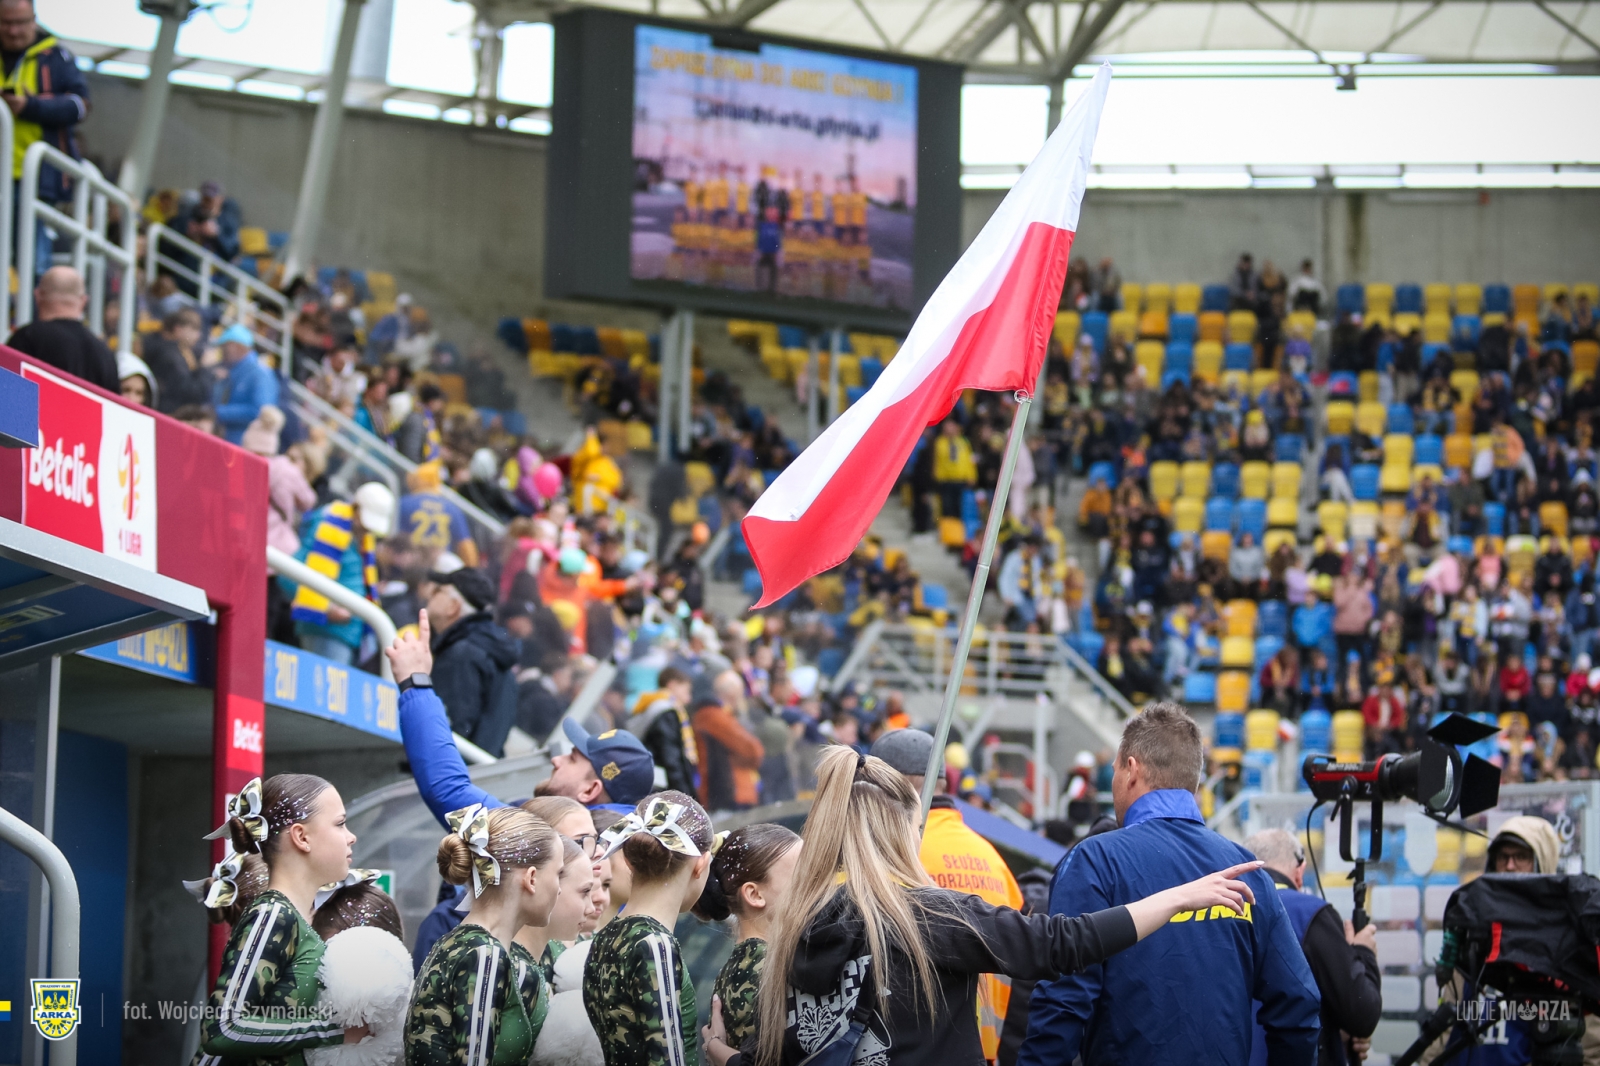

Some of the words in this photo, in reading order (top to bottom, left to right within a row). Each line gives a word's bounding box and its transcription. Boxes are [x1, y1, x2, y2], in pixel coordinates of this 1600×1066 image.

[29, 428, 95, 508] Betclic
[1364, 782, 1373, 795] 2
[942, 852, 993, 874] SŁUŻBA
